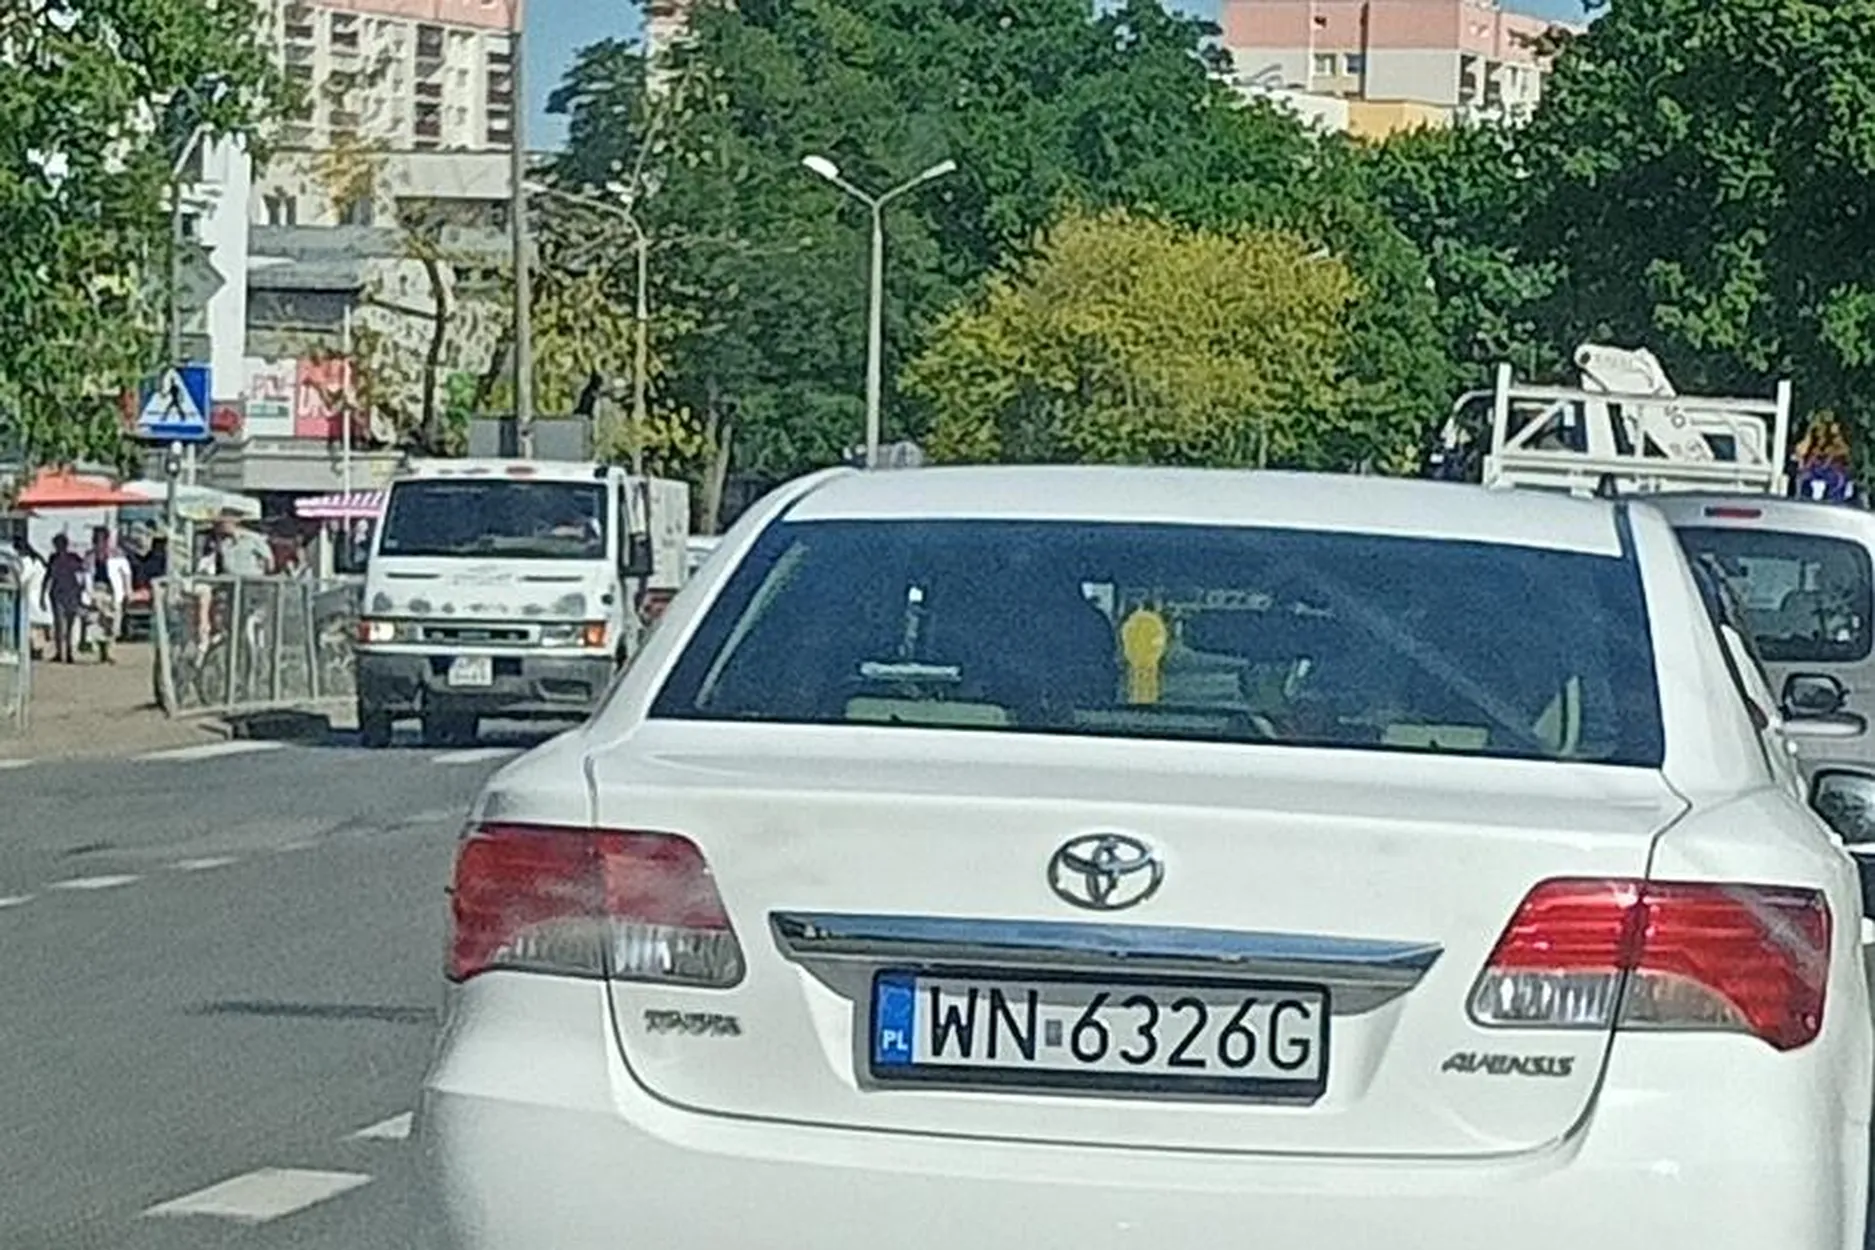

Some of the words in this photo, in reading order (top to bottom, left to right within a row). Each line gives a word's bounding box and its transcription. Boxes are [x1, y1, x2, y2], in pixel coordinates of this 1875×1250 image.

[883, 1029, 909, 1051] PL
[930, 986, 1038, 1061] WN
[1070, 992, 1311, 1070] 6326G
